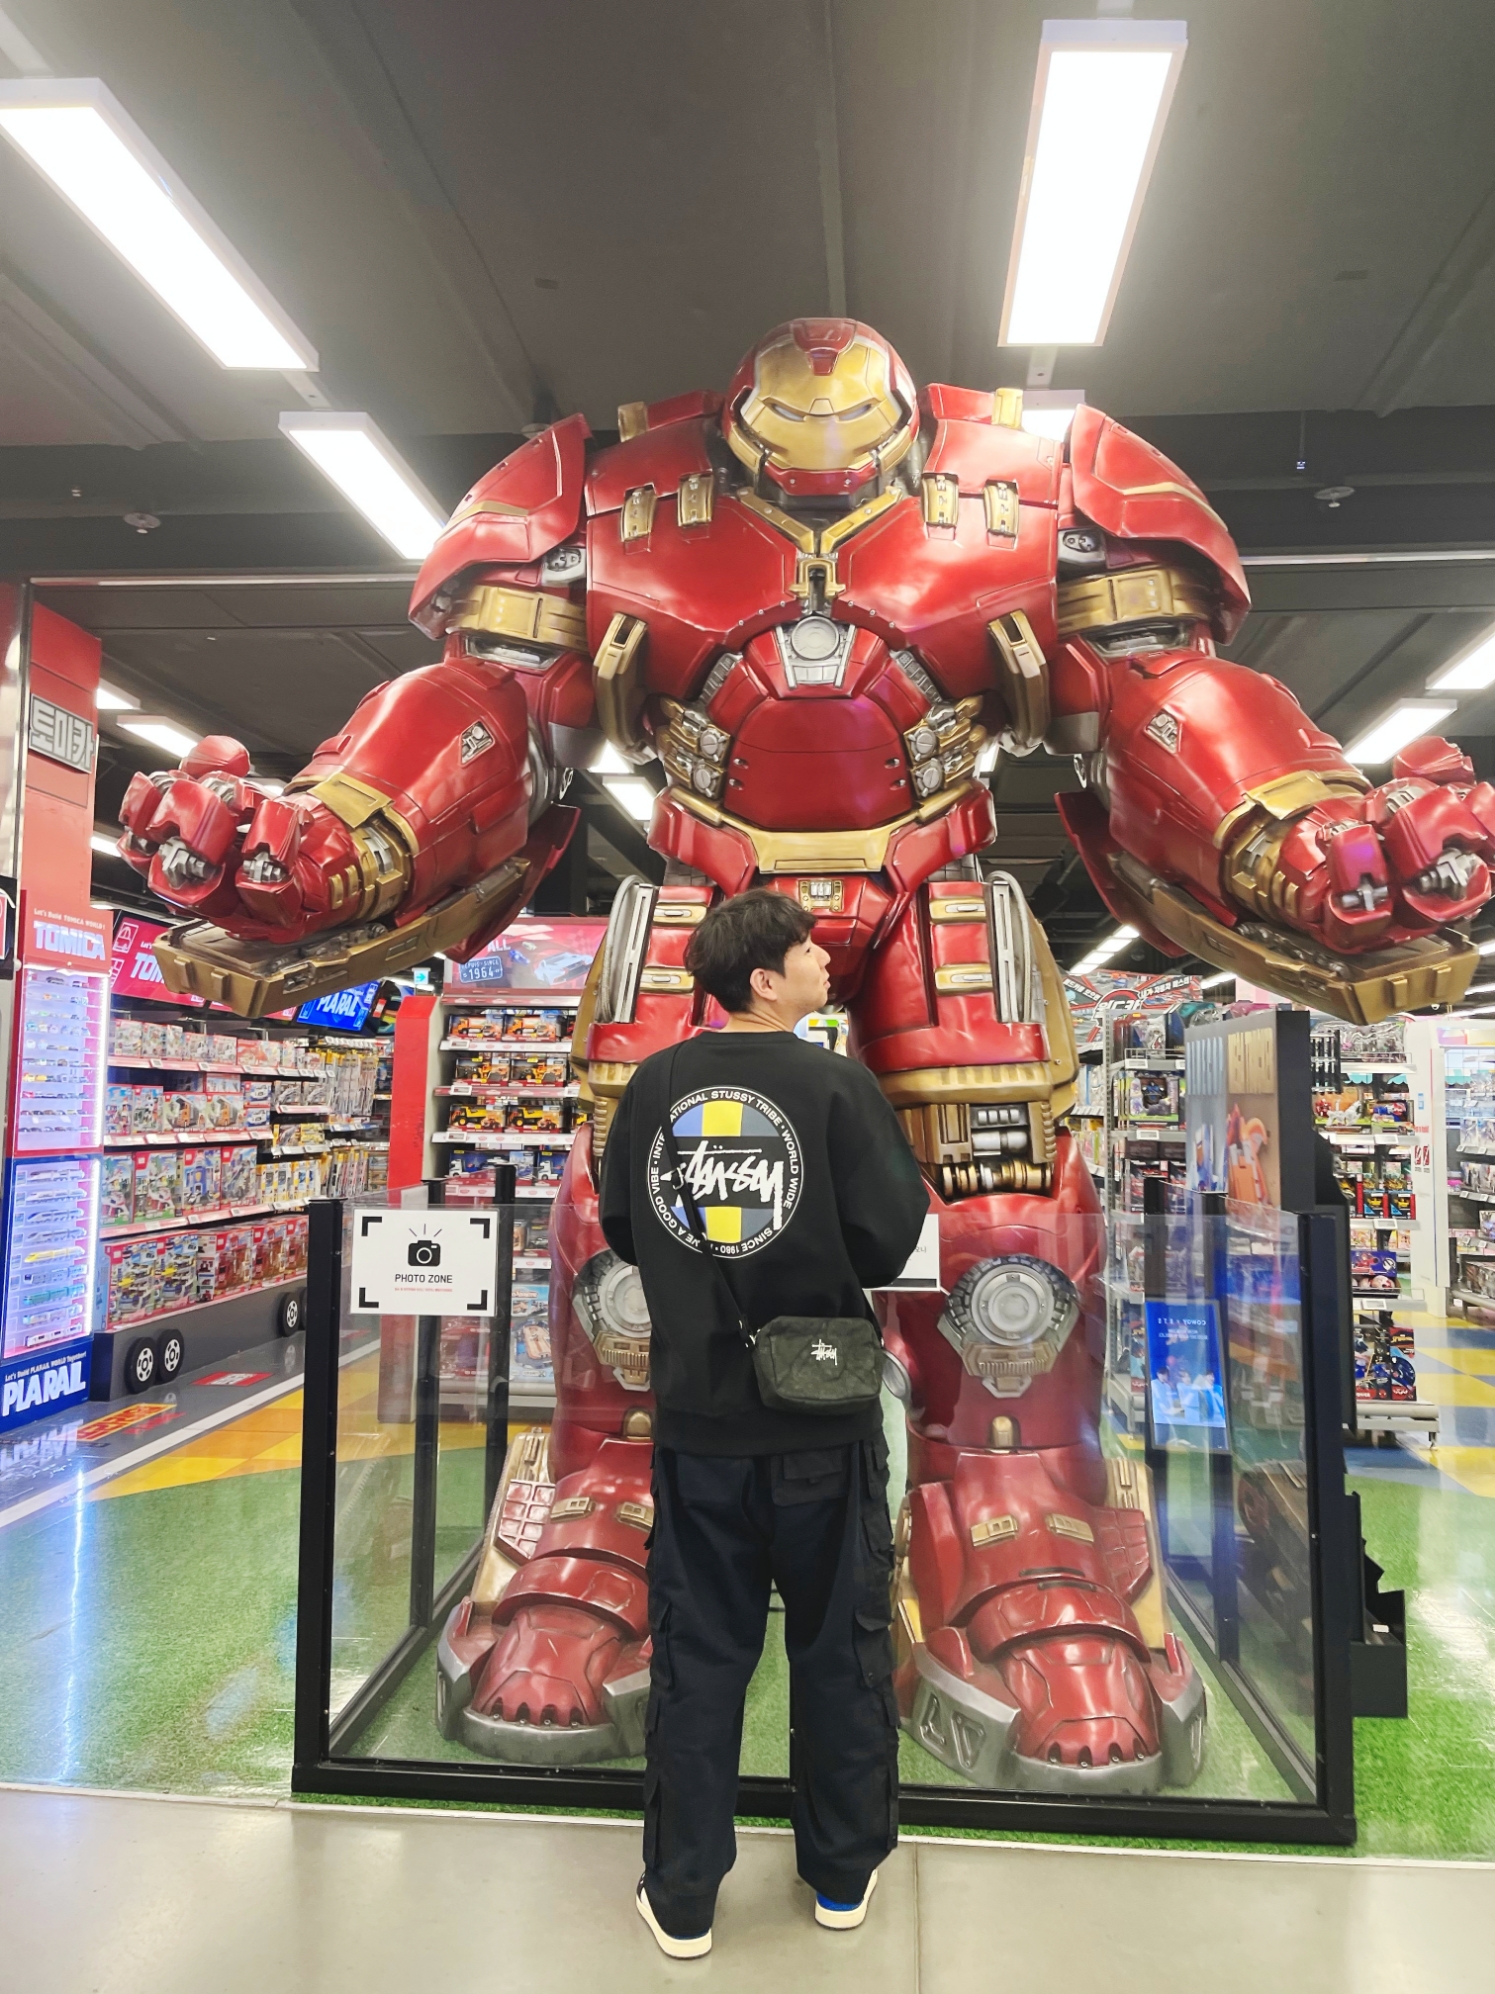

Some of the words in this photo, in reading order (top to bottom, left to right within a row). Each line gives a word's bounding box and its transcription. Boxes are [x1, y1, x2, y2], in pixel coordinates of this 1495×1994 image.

[32, 699, 94, 769] 토미카
[64, 915, 84, 925] TOMICA
[33, 920, 106, 960] TOMICA
[130, 952, 165, 985] TOM
[469, 966, 494, 980] 1964
[711, 1090, 756, 1105] STUSSY
[755, 1098, 783, 1127] TRIBE
[781, 1129, 799, 1175] WORLD
[650, 1166, 661, 1195] VIBE
[782, 1178, 800, 1210] WIDE
[654, 1196, 678, 1229] GOOD
[677, 1226, 687, 1236] A
[742, 1226, 774, 1248] SINCE
[719, 1244, 740, 1255] 1980
[394, 1273, 426, 1283] PHOTO
[427, 1274, 453, 1284] ZONE
[5, 1373, 17, 1382] Let's
